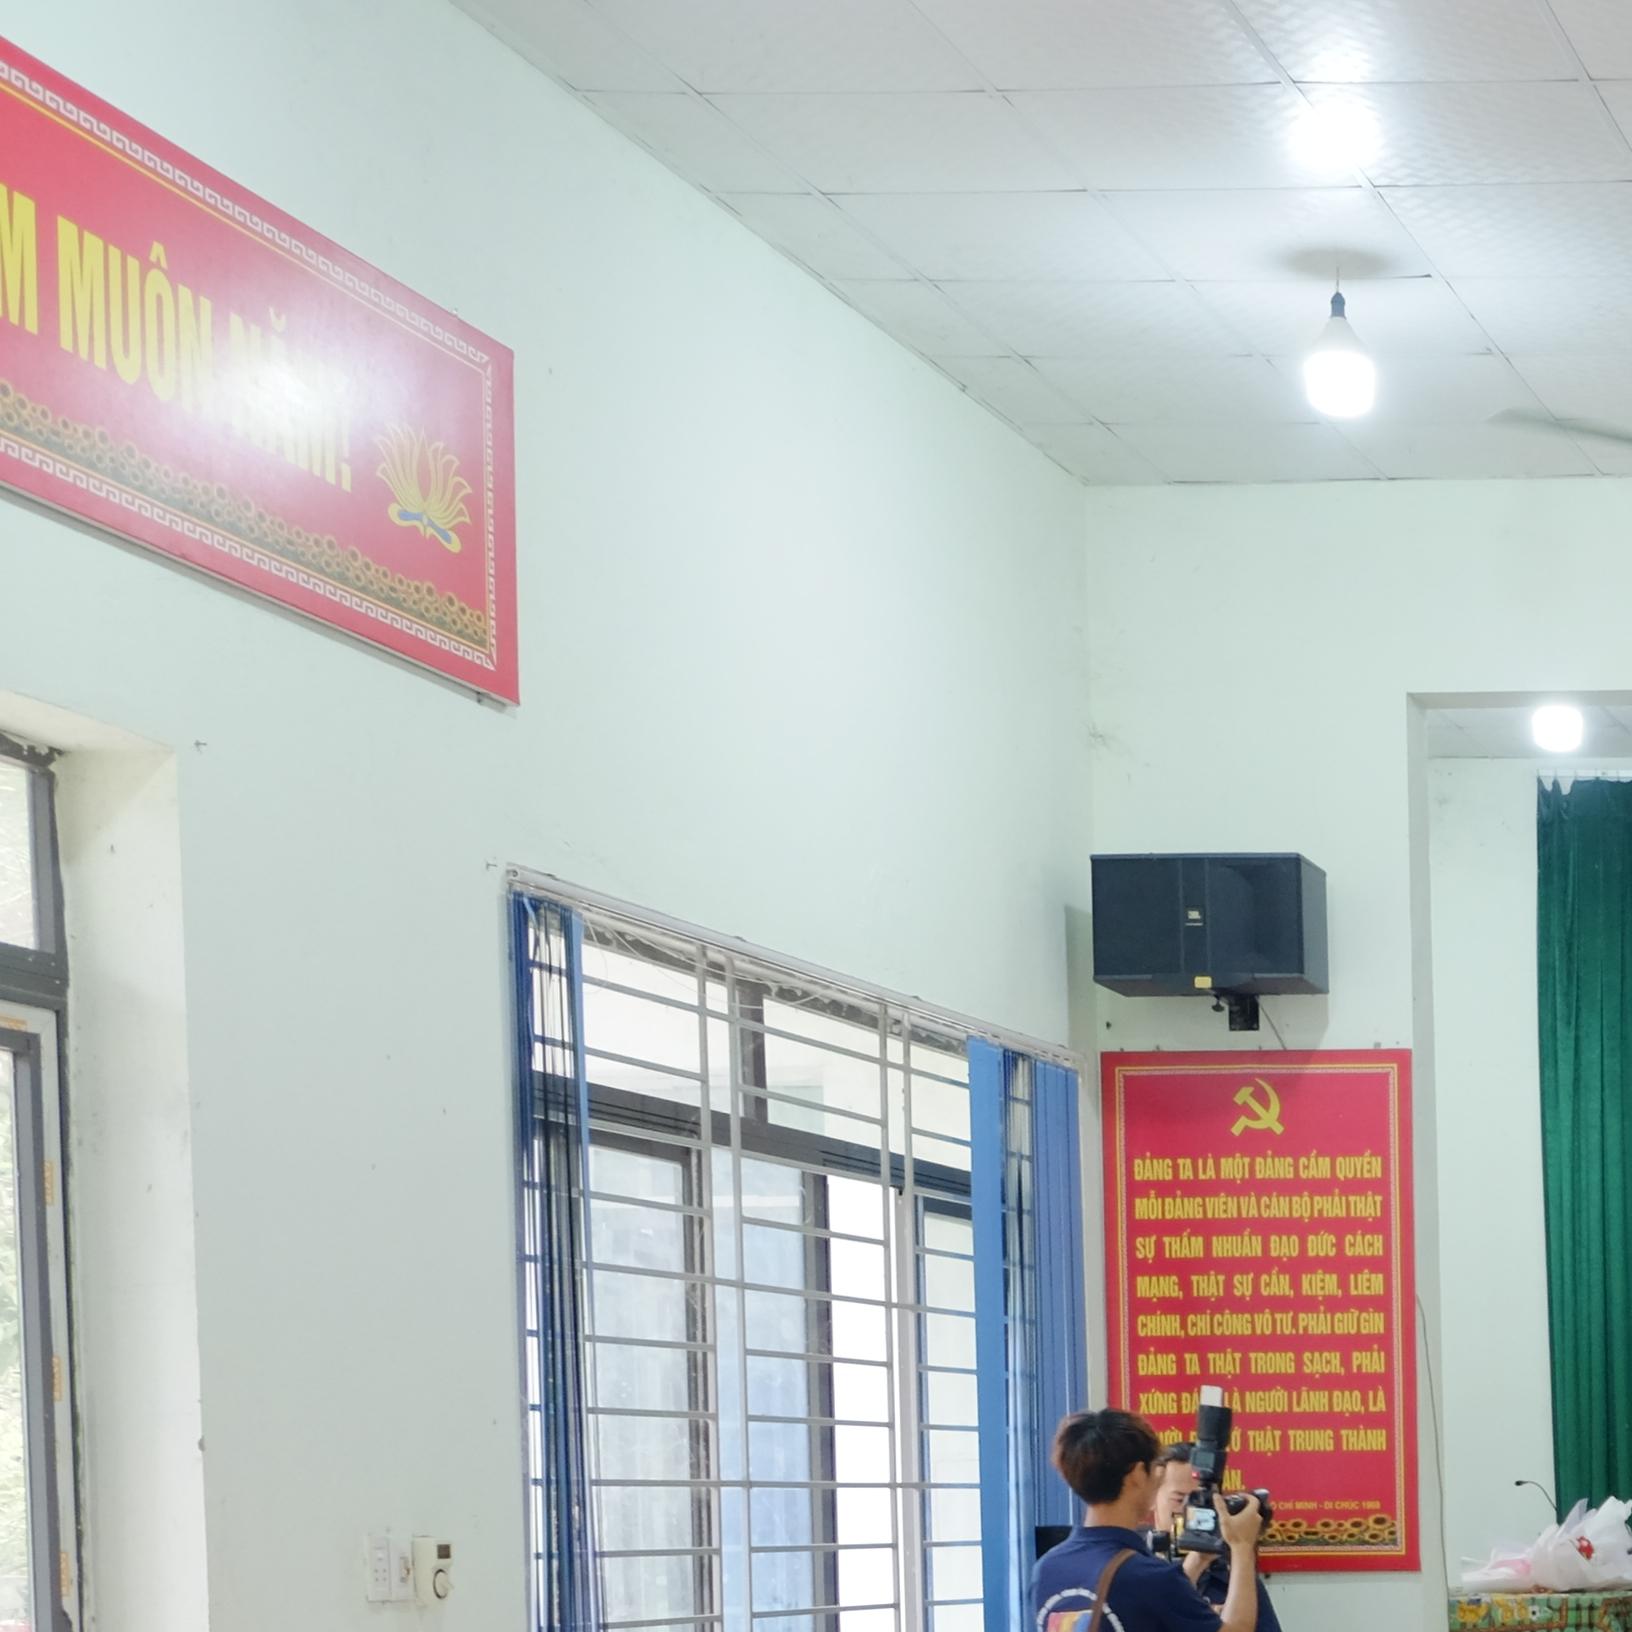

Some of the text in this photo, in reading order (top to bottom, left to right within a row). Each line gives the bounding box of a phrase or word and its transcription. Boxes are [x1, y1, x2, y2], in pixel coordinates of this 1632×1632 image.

[58, 215, 213, 414] MUÔN
[1134, 1153, 1172, 1180] ĐẢNG
[1177, 1158, 1193, 1179] TA
[1198, 1154, 1216, 1179] LÀ
[1221, 1153, 1250, 1183] MỘT
[1255, 1150, 1294, 1179] ĐẢNG
[1165, 1191, 1203, 1219] ĐẢNG
[1206, 1193, 1237, 1218] VIÊN
[1240, 1192, 1258, 1218] VÀ
[1260, 1192, 1290, 1218] CÁN
[1292, 1192, 1311, 1222] BỘ
[1314, 1189, 1346, 1218] PHẢI
[1349, 1191, 1382, 1221] THẬT
[1136, 1235, 1155, 1263] SỰ
[1163, 1230, 1204, 1258] THẤM
[1271, 1235, 1299, 1261] ĐẠO
[1308, 1230, 1336, 1257] ĐỨC
[1345, 1230, 1383, 1256] CÁCH
[1137, 1276, 1183, 1301] MẠNG,
[1191, 1271, 1225, 1301] THẬT
[1234, 1273, 1253, 1300] SỰ
[1302, 1269, 1342, 1300] KIỆM,
[1350, 1269, 1383, 1295] LIÊM
[1138, 1312, 1184, 1337] CHÍNH,
[1214, 1310, 1252, 1335] CÔNG
[1255, 1309, 1272, 1335] VÔ
[1275, 1311, 1296, 1335] TƯ.
[1299, 1306, 1331, 1334] PHẢI
[1360, 1308, 1384, 1334] GÌN
[1138, 1344, 1385, 1378] ĐẢNG TA THẬT TRONG SẠCH, PHẢI
[1140, 1386, 1386, 1416] XỨNG ĐÁ LÀ NGƯỜI LÃNH ĐẠO, LÀ
[1248, 1425, 1281, 1456] THẬT
[1288, 1430, 1334, 1450] TRUNG
[1341, 1425, 1386, 1450] THÀNH
